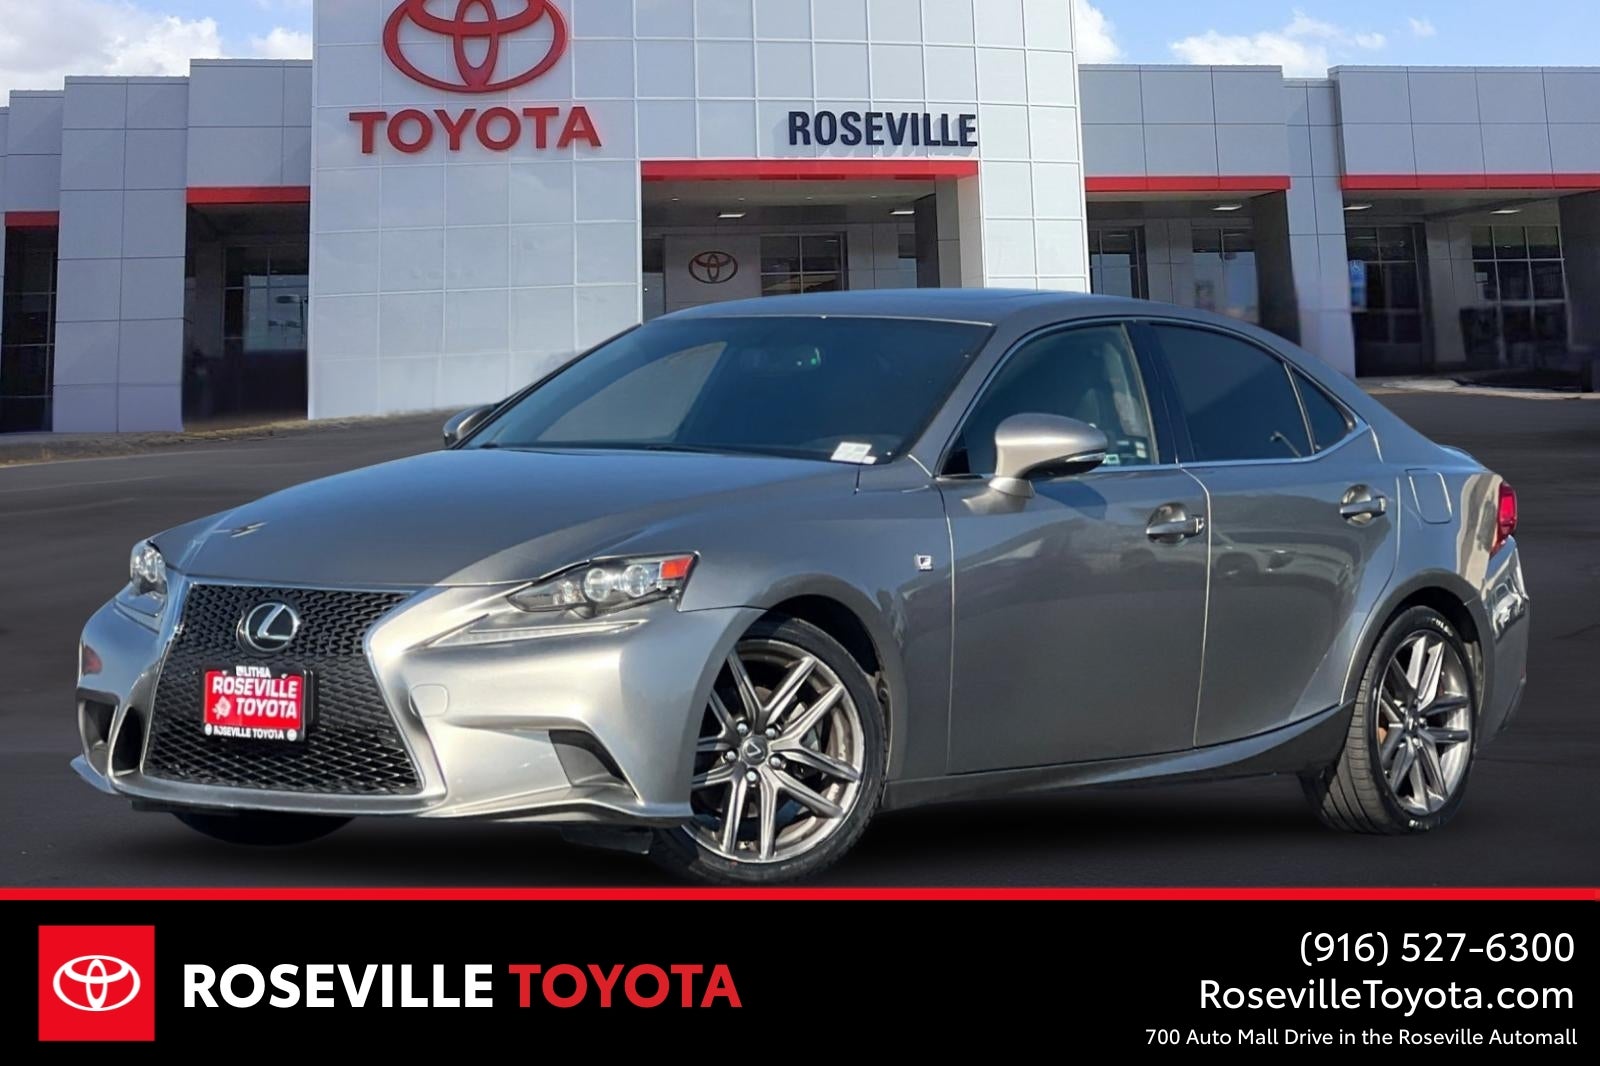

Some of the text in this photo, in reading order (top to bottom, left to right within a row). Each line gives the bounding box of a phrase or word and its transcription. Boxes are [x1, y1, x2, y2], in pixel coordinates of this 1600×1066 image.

[349, 105, 602, 154] TOYOTA
[788, 110, 979, 148] ROSEVILLE
[245, 667, 271, 678] LITHIA
[212, 676, 298, 699] ROSEVILLE
[236, 697, 298, 719] TOYOTA
[252, 728, 285, 740] TOYOTA
